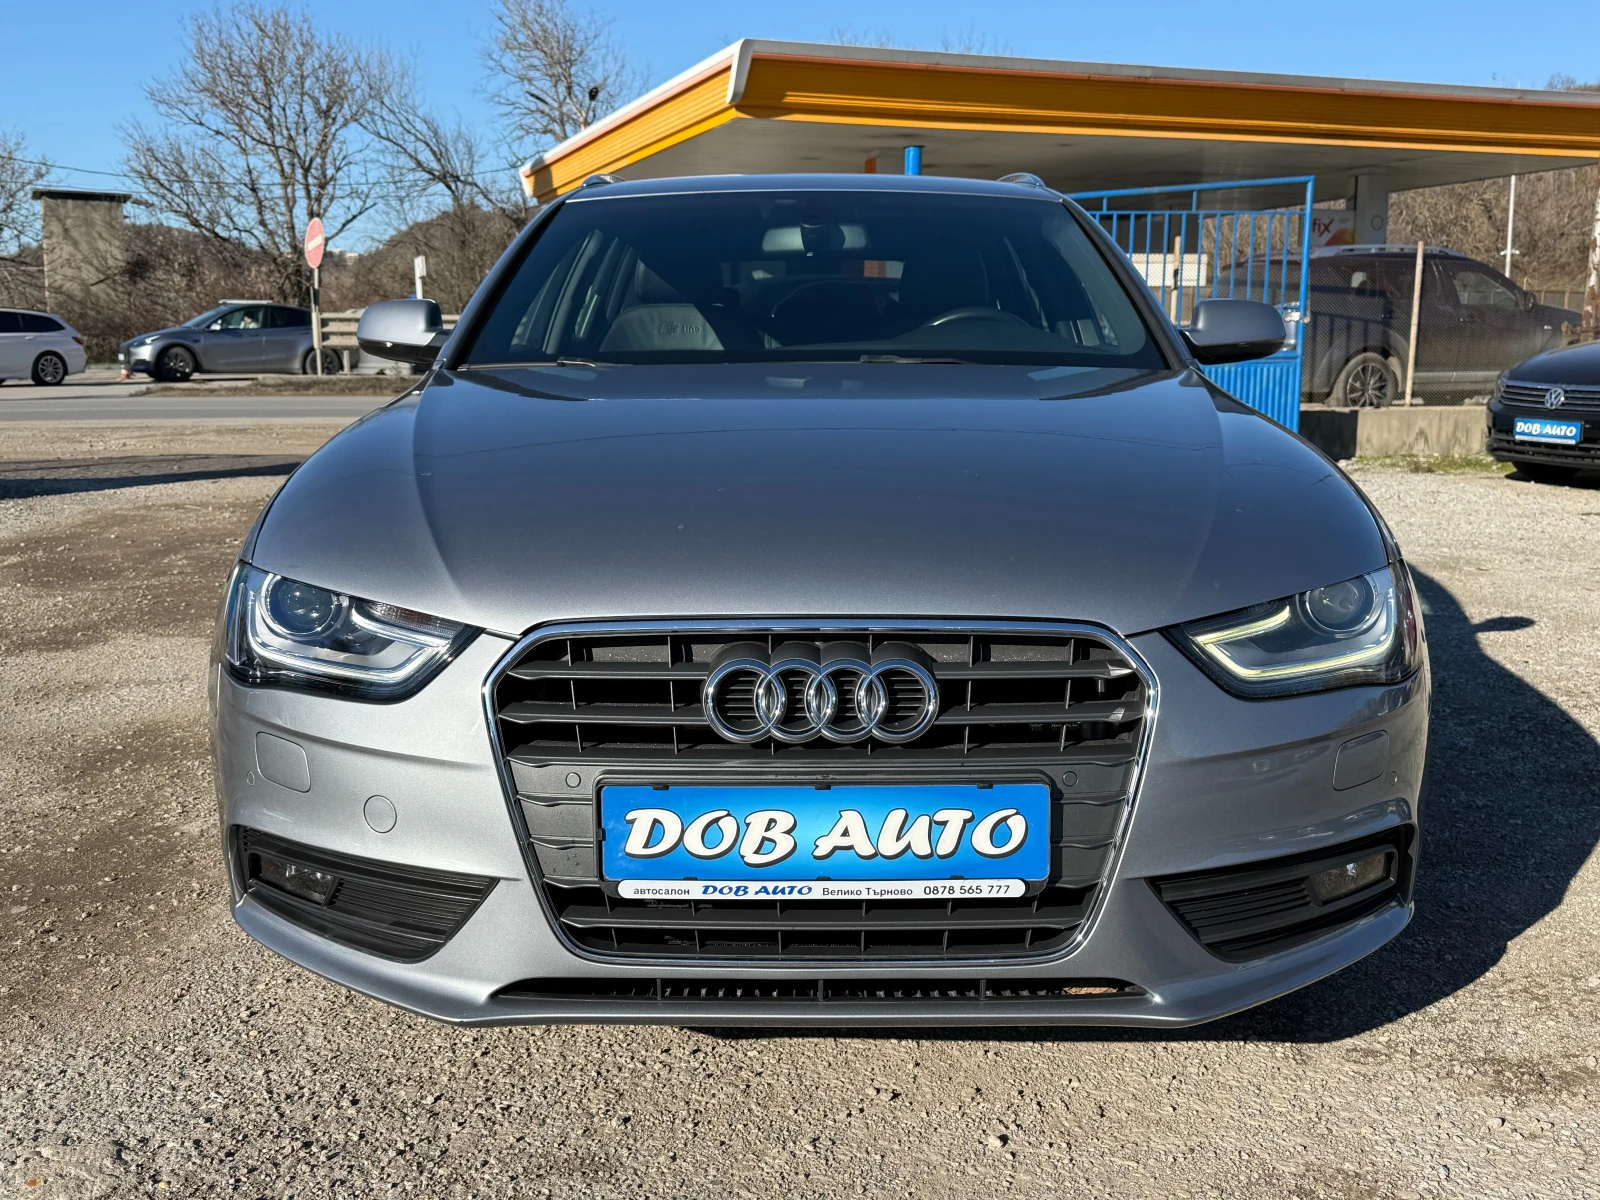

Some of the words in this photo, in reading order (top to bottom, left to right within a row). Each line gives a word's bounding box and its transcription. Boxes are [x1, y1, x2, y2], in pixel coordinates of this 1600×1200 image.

[1515, 421, 1541, 435] DOB
[1542, 424, 1577, 437] AUTO
[624, 807, 798, 868] DOB
[812, 807, 1029, 861] AUTO
[633, 887, 690, 896] автосалон
[702, 884, 749, 897] DOB
[753, 885, 813, 896] AUTO
[822, 887, 862, 896] Велико
[865, 887, 913, 898] Търново
[923, 885, 955, 896] 0878
[959, 885, 983, 895] 565
[987, 884, 1011, 895] 777
